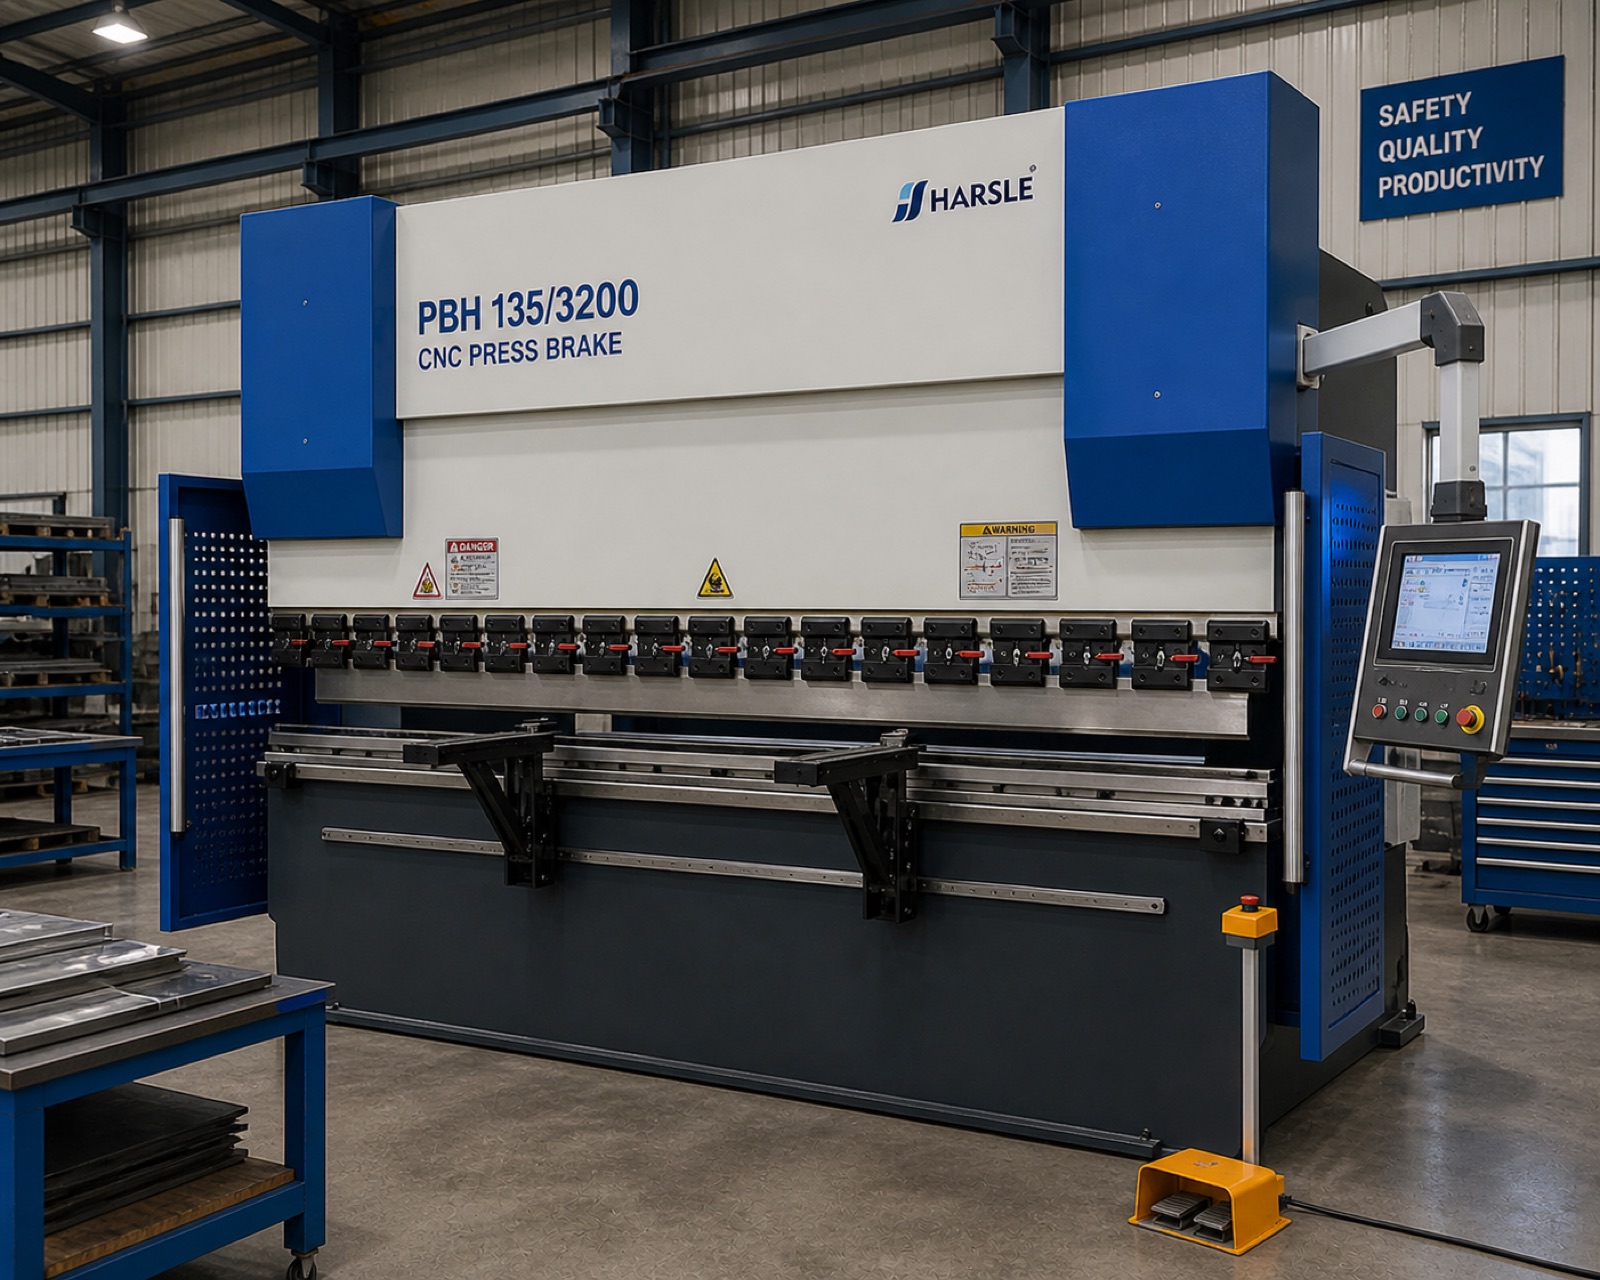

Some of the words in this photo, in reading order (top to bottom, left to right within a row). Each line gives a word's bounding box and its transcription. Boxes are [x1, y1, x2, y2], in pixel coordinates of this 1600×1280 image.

[1378, 91, 1472, 127] SAFETY
[1378, 126, 1484, 163] QUALITY
[930, 176, 1034, 212] HARSLE
[1378, 155, 1545, 199] PRODUCTIVITY
[418, 295, 482, 335] PBH
[491, 278, 639, 328] 135/3200
[418, 345, 462, 370] CNC
[469, 339, 539, 366] PRESS
[546, 331, 623, 360] BRAKE
[991, 525, 1036, 535] WARNING
